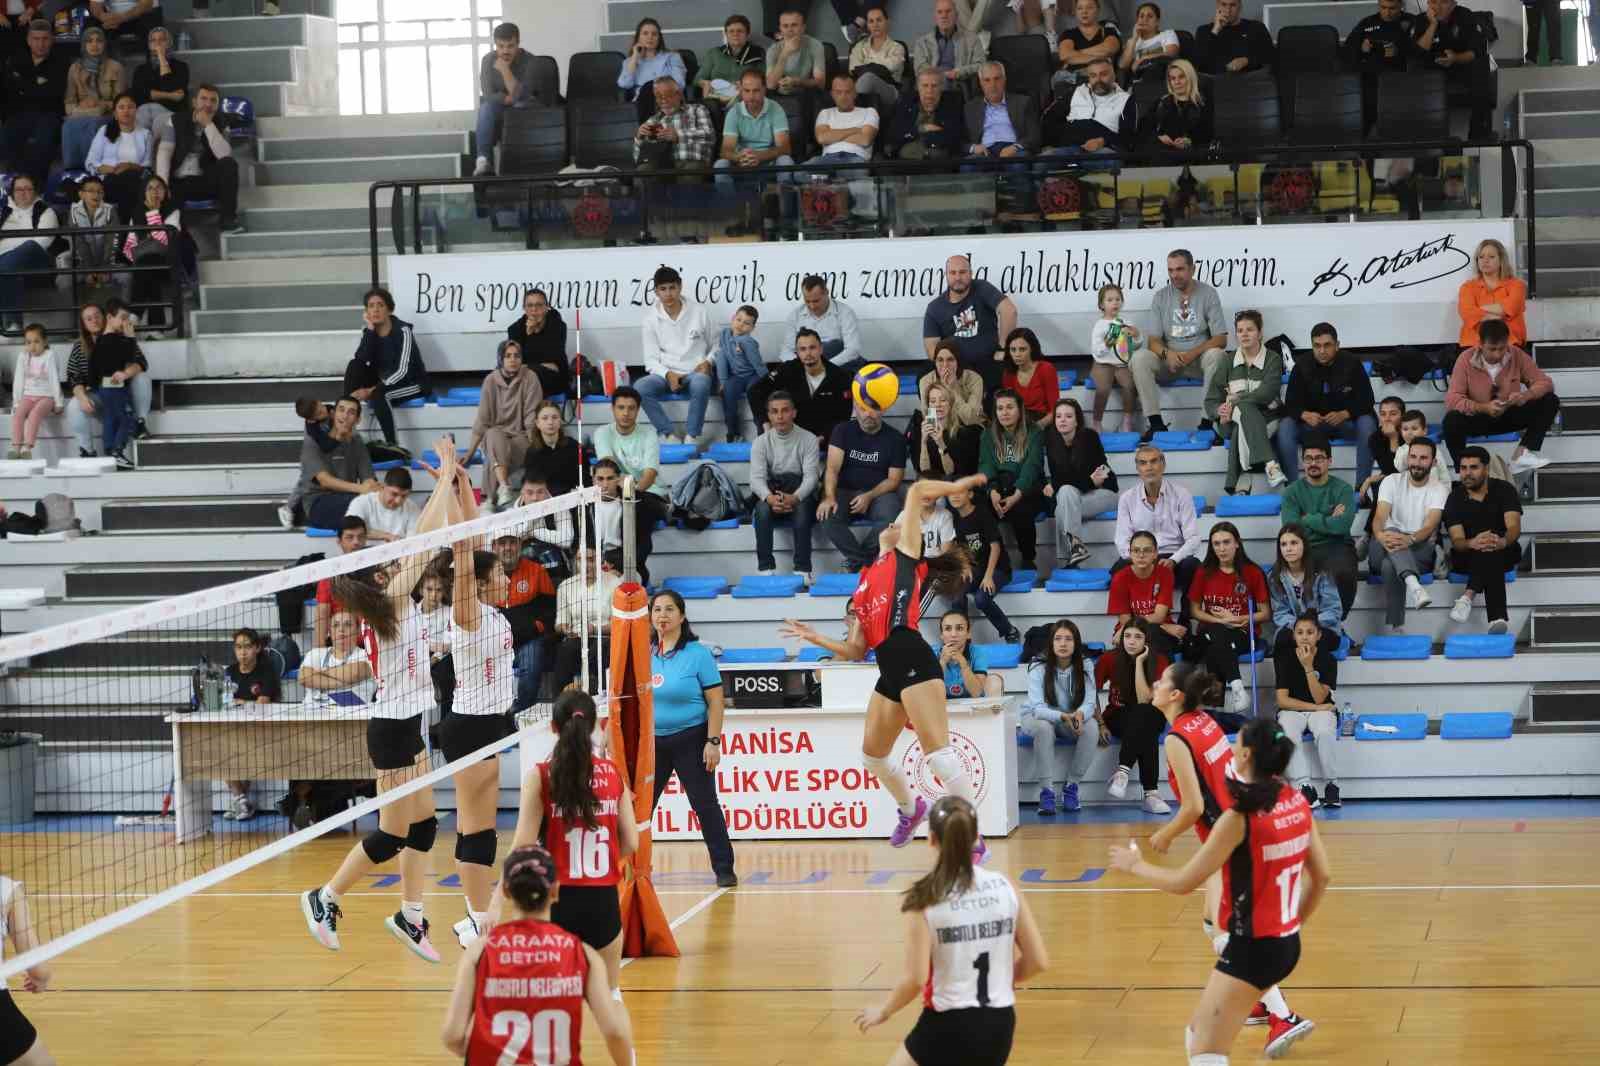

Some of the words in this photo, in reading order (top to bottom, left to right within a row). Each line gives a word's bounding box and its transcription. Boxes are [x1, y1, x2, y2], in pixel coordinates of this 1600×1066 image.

[416, 273, 465, 314] Ben
[475, 279, 620, 323] sporunun
[786, 271, 849, 301] anı
[734, 676, 784, 693] POSS.
[764, 770, 801, 792] VE
[807, 768, 881, 793] SPOR
[656, 805, 681, 832] İL
[564, 825, 610, 880] 16
[1275, 860, 1305, 925] 17
[499, 950, 561, 965] BETON
[972, 951, 991, 1007] 1
[490, 1009, 573, 1066] 20
